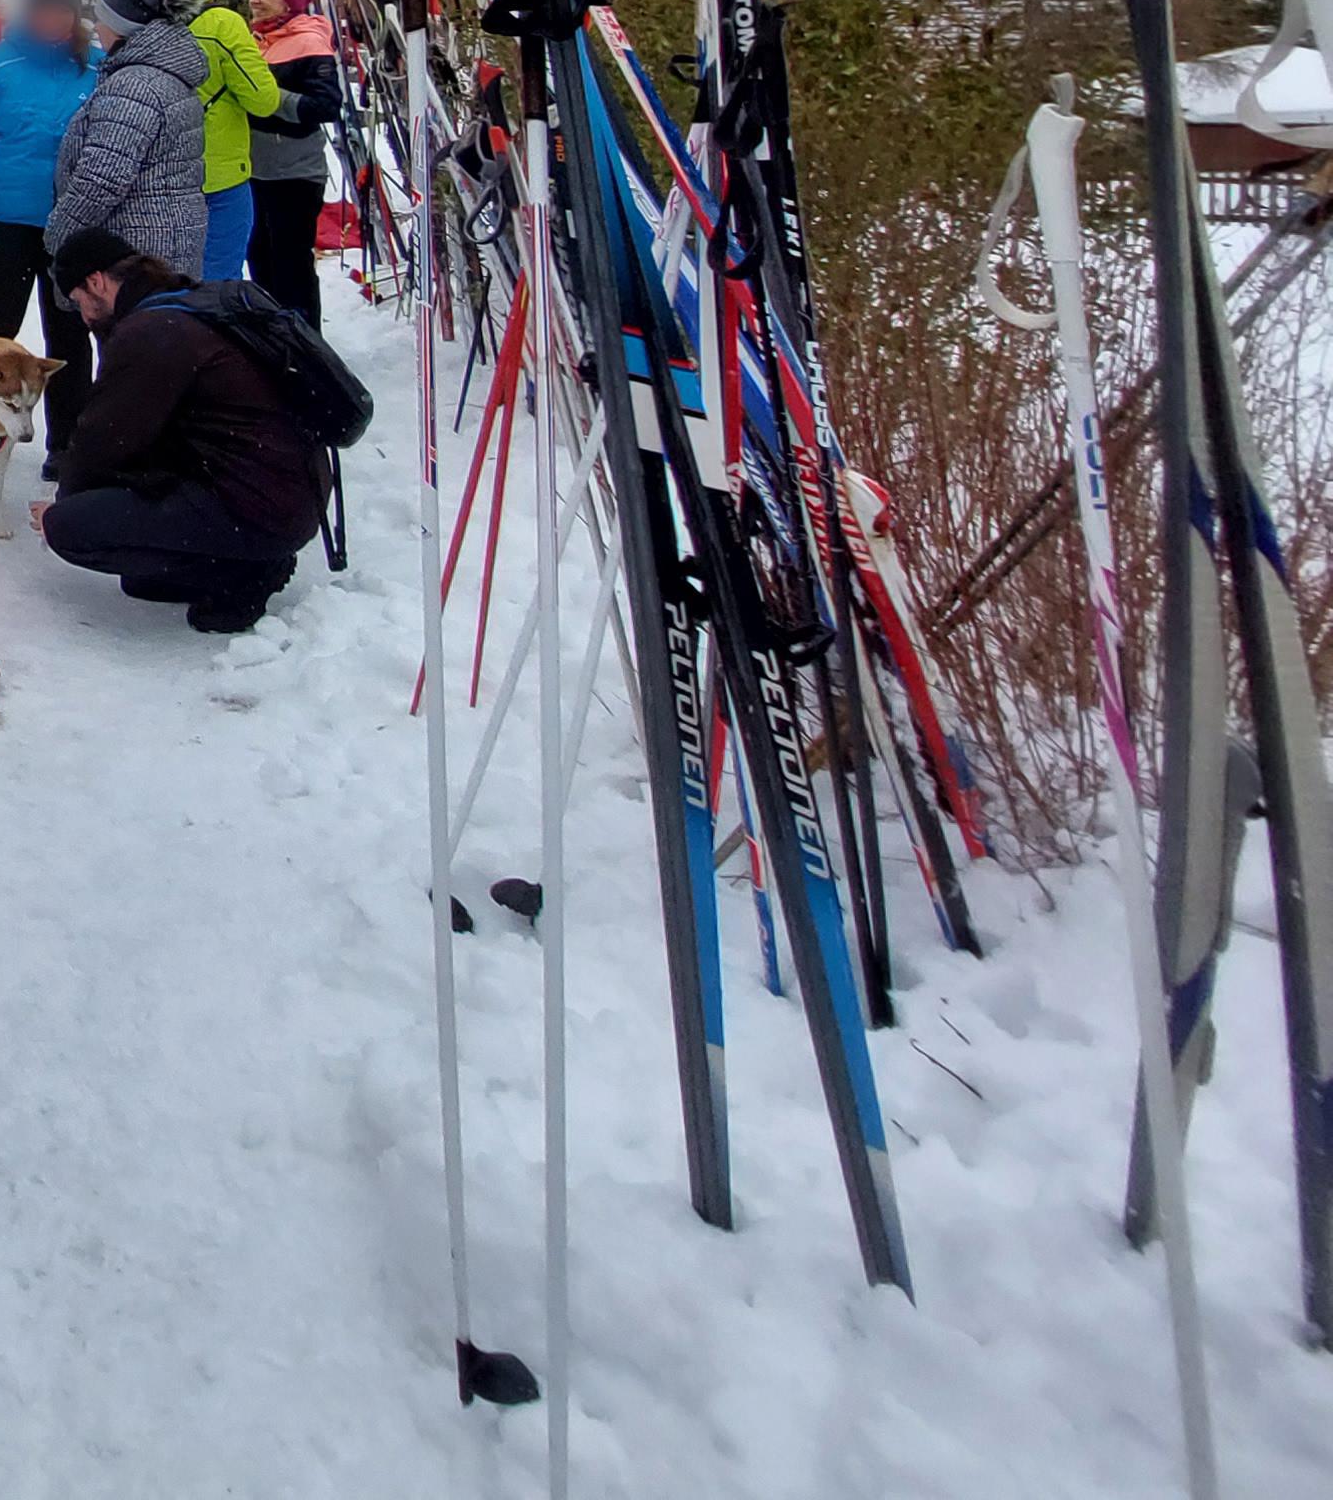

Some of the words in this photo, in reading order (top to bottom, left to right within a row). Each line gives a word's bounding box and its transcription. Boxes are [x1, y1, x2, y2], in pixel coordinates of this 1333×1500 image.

[554, 132, 566, 163] PRO
[781, 197, 802, 257] LEKI
[665, 601, 708, 810] PELTONEN
[751, 649, 831, 880] PELTONEN
